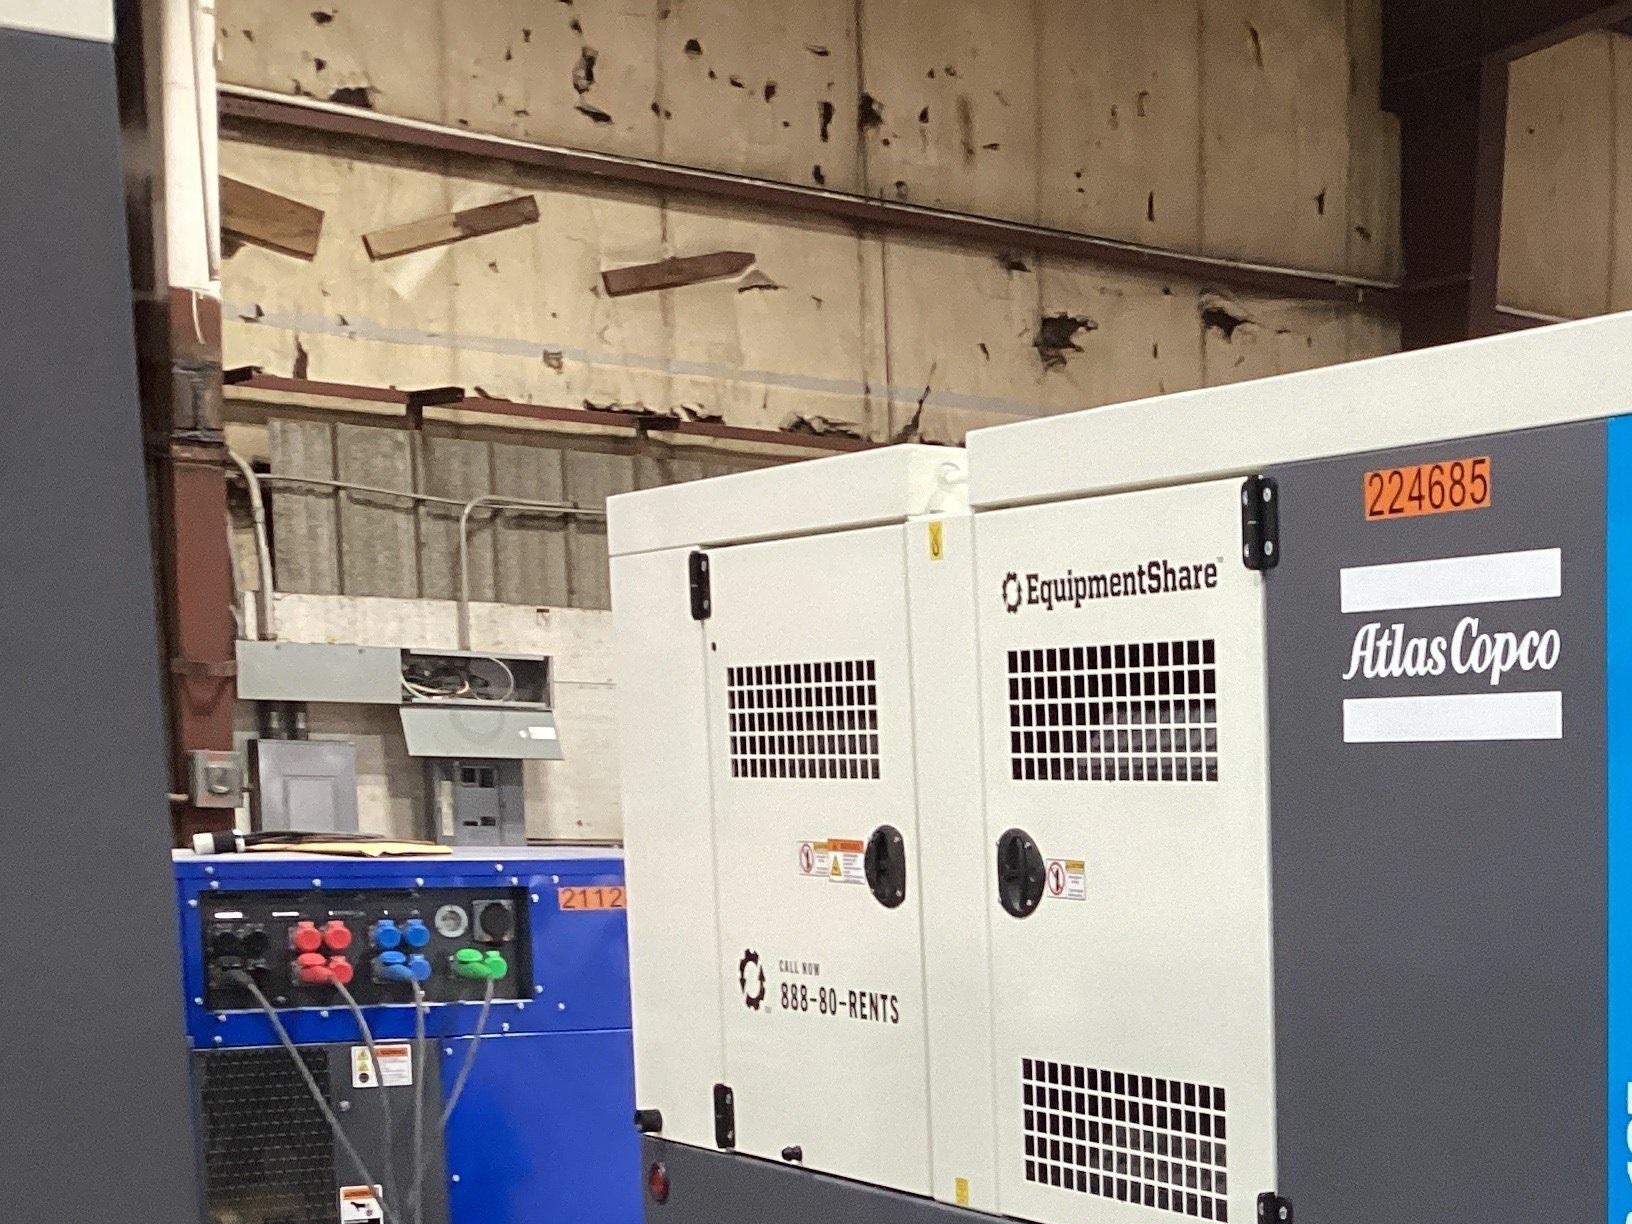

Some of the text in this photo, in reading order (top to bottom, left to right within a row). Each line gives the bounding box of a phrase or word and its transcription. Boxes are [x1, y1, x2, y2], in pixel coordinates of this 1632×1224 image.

[1368, 458, 1487, 517] 224685
[1026, 559, 1218, 611] EquipmentShare
[1342, 616, 1561, 686] Atlas Copco
[779, 959, 820, 976] CALL NOW
[780, 981, 899, 1024] 888-80-RENTS
